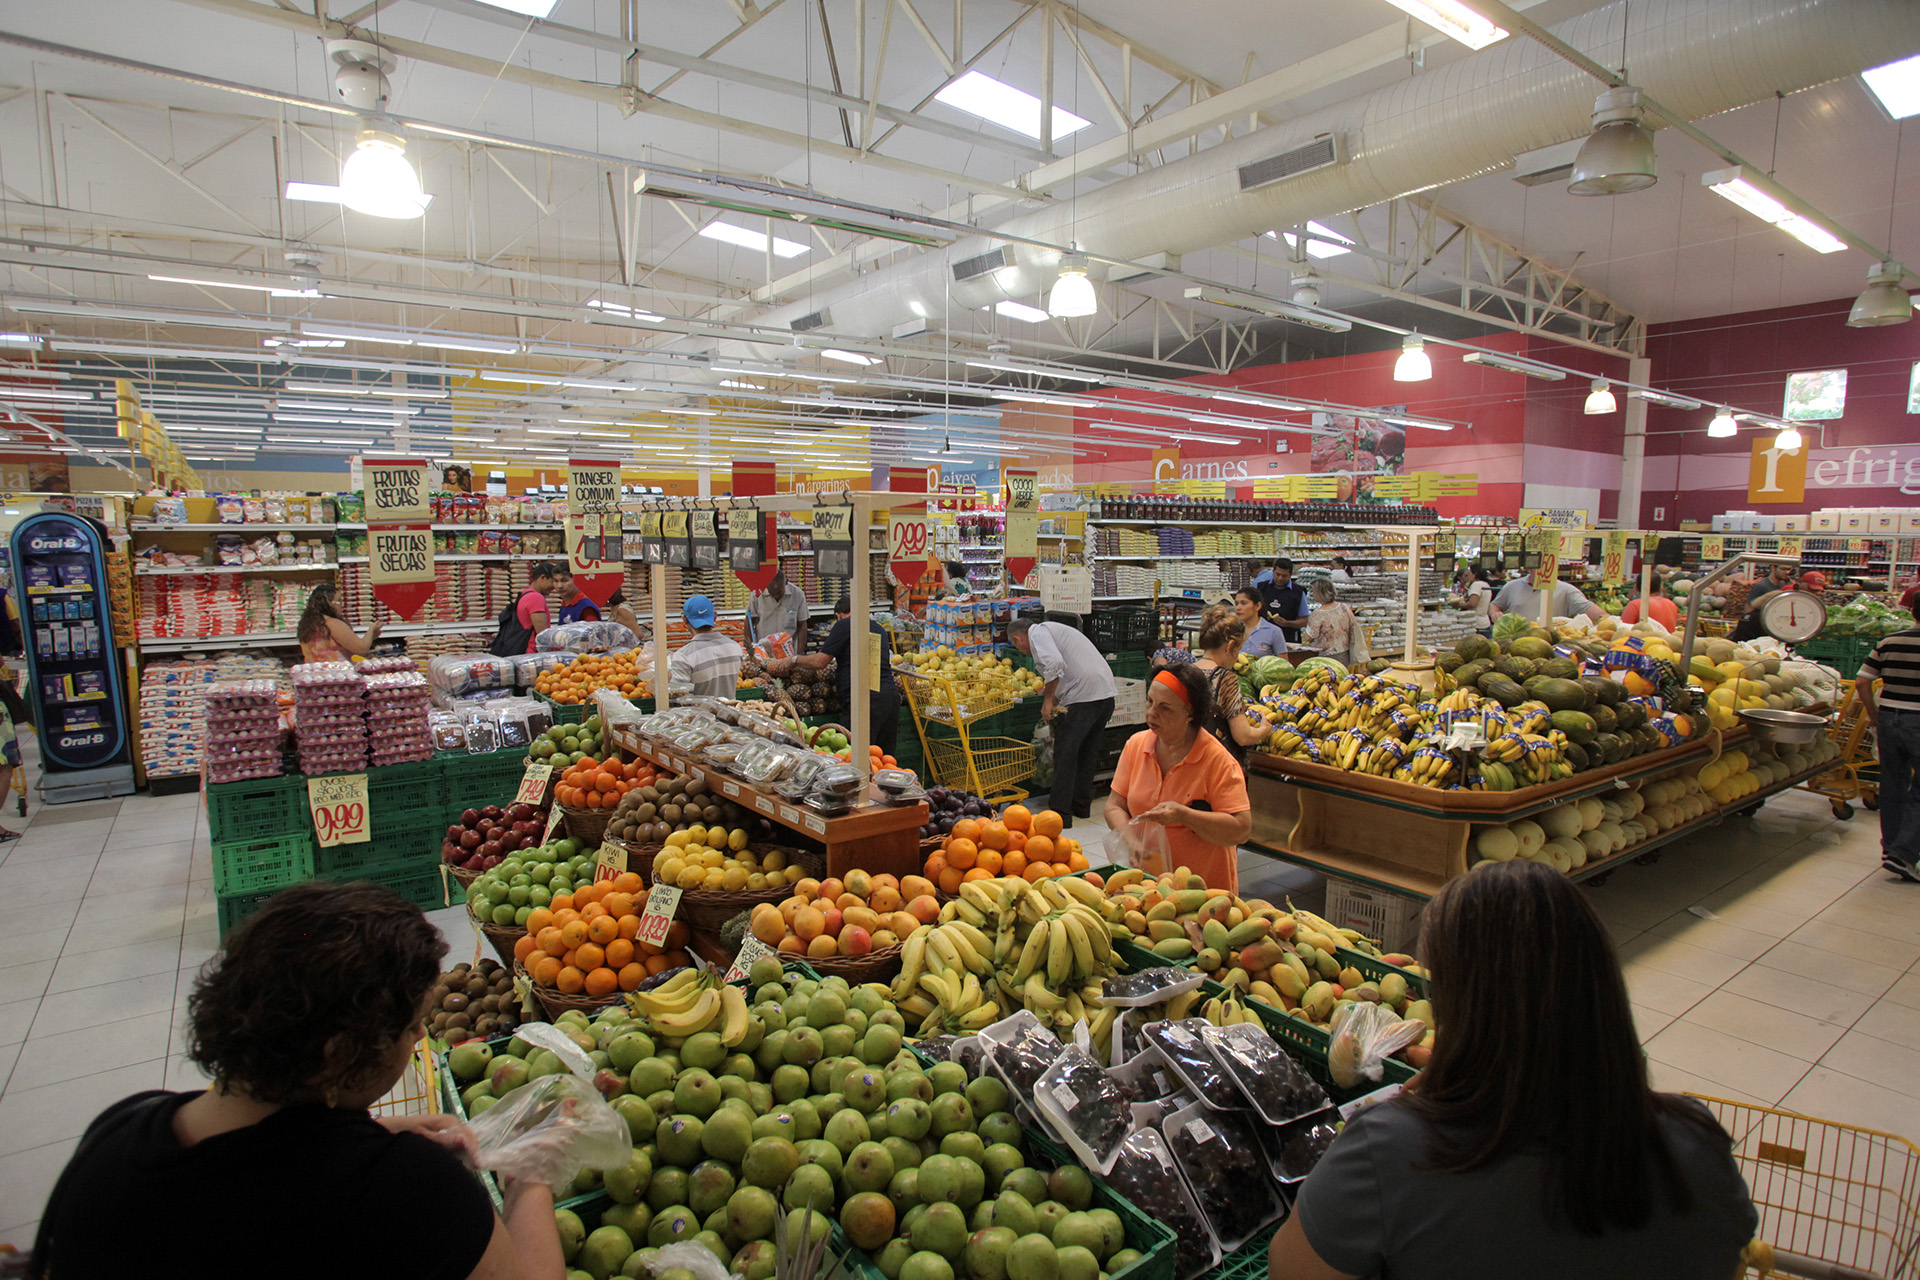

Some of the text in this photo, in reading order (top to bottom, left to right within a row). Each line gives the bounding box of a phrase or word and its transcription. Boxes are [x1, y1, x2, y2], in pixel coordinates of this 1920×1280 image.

[372, 470, 420, 488] FRUTAS
[572, 472, 616, 485] TANGER.
[1012, 479, 1034, 491] COCO
[375, 487, 420, 508] SECAS
[575, 487, 615, 501] COMUM
[1015, 491, 1035, 501] VERDE
[813, 512, 844, 529] SAPOTI
[30, 538, 77, 549] Oral-B
[377, 535, 427, 552] FRUTAS
[380, 553, 426, 572] SECAS
[60, 733, 105, 747] Oral-B
[315, 802, 364, 842] 9,99
[604, 845, 620, 858] KIWI
